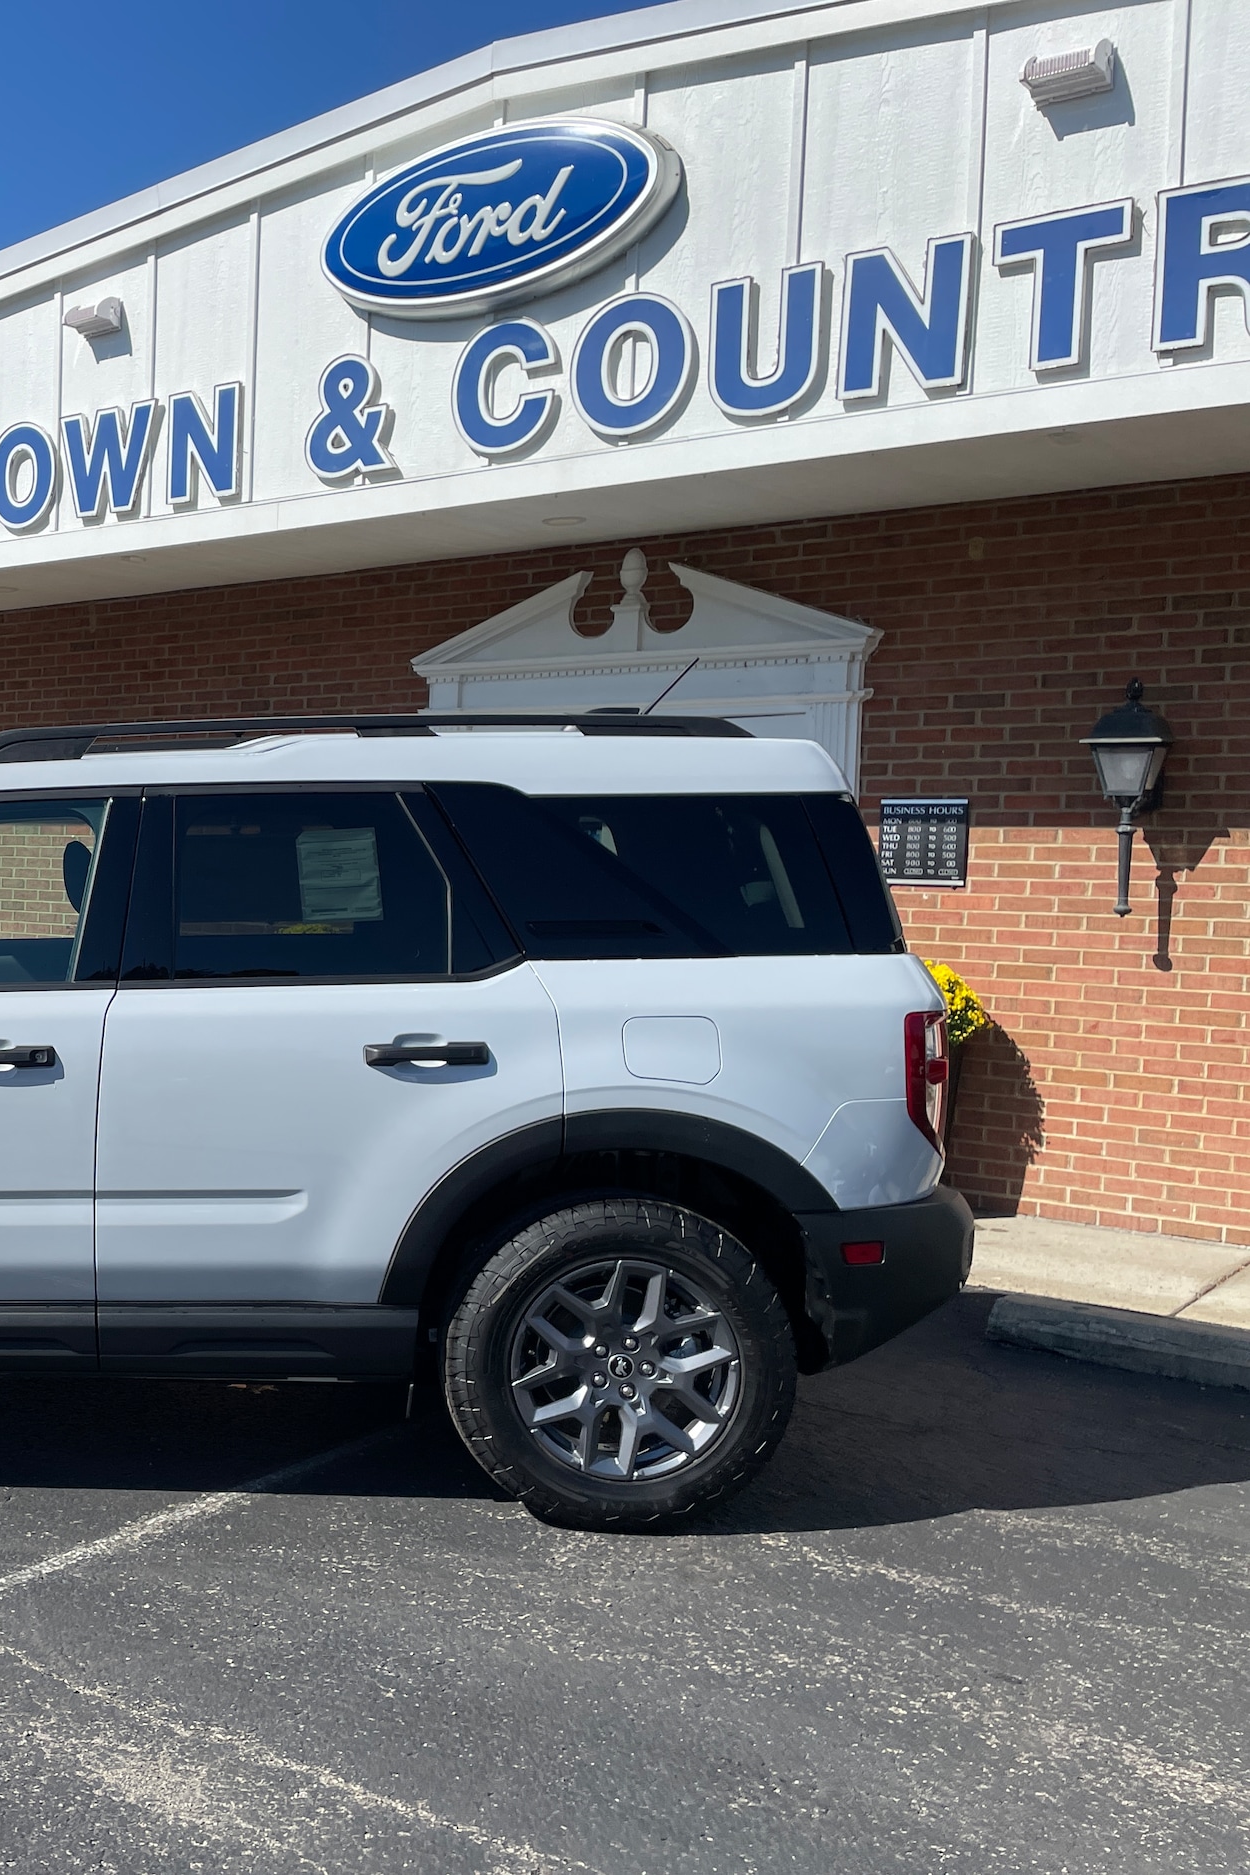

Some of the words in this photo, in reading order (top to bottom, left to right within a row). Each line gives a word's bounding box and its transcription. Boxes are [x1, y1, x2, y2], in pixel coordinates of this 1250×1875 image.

[377, 158, 575, 278] Ford
[305, 353, 397, 480] &
[452, 174, 1250, 457] COUNTR
[883, 806, 926, 815] BUSINESS
[928, 806, 964, 815] HOURS
[881, 859, 894, 867] SAT
